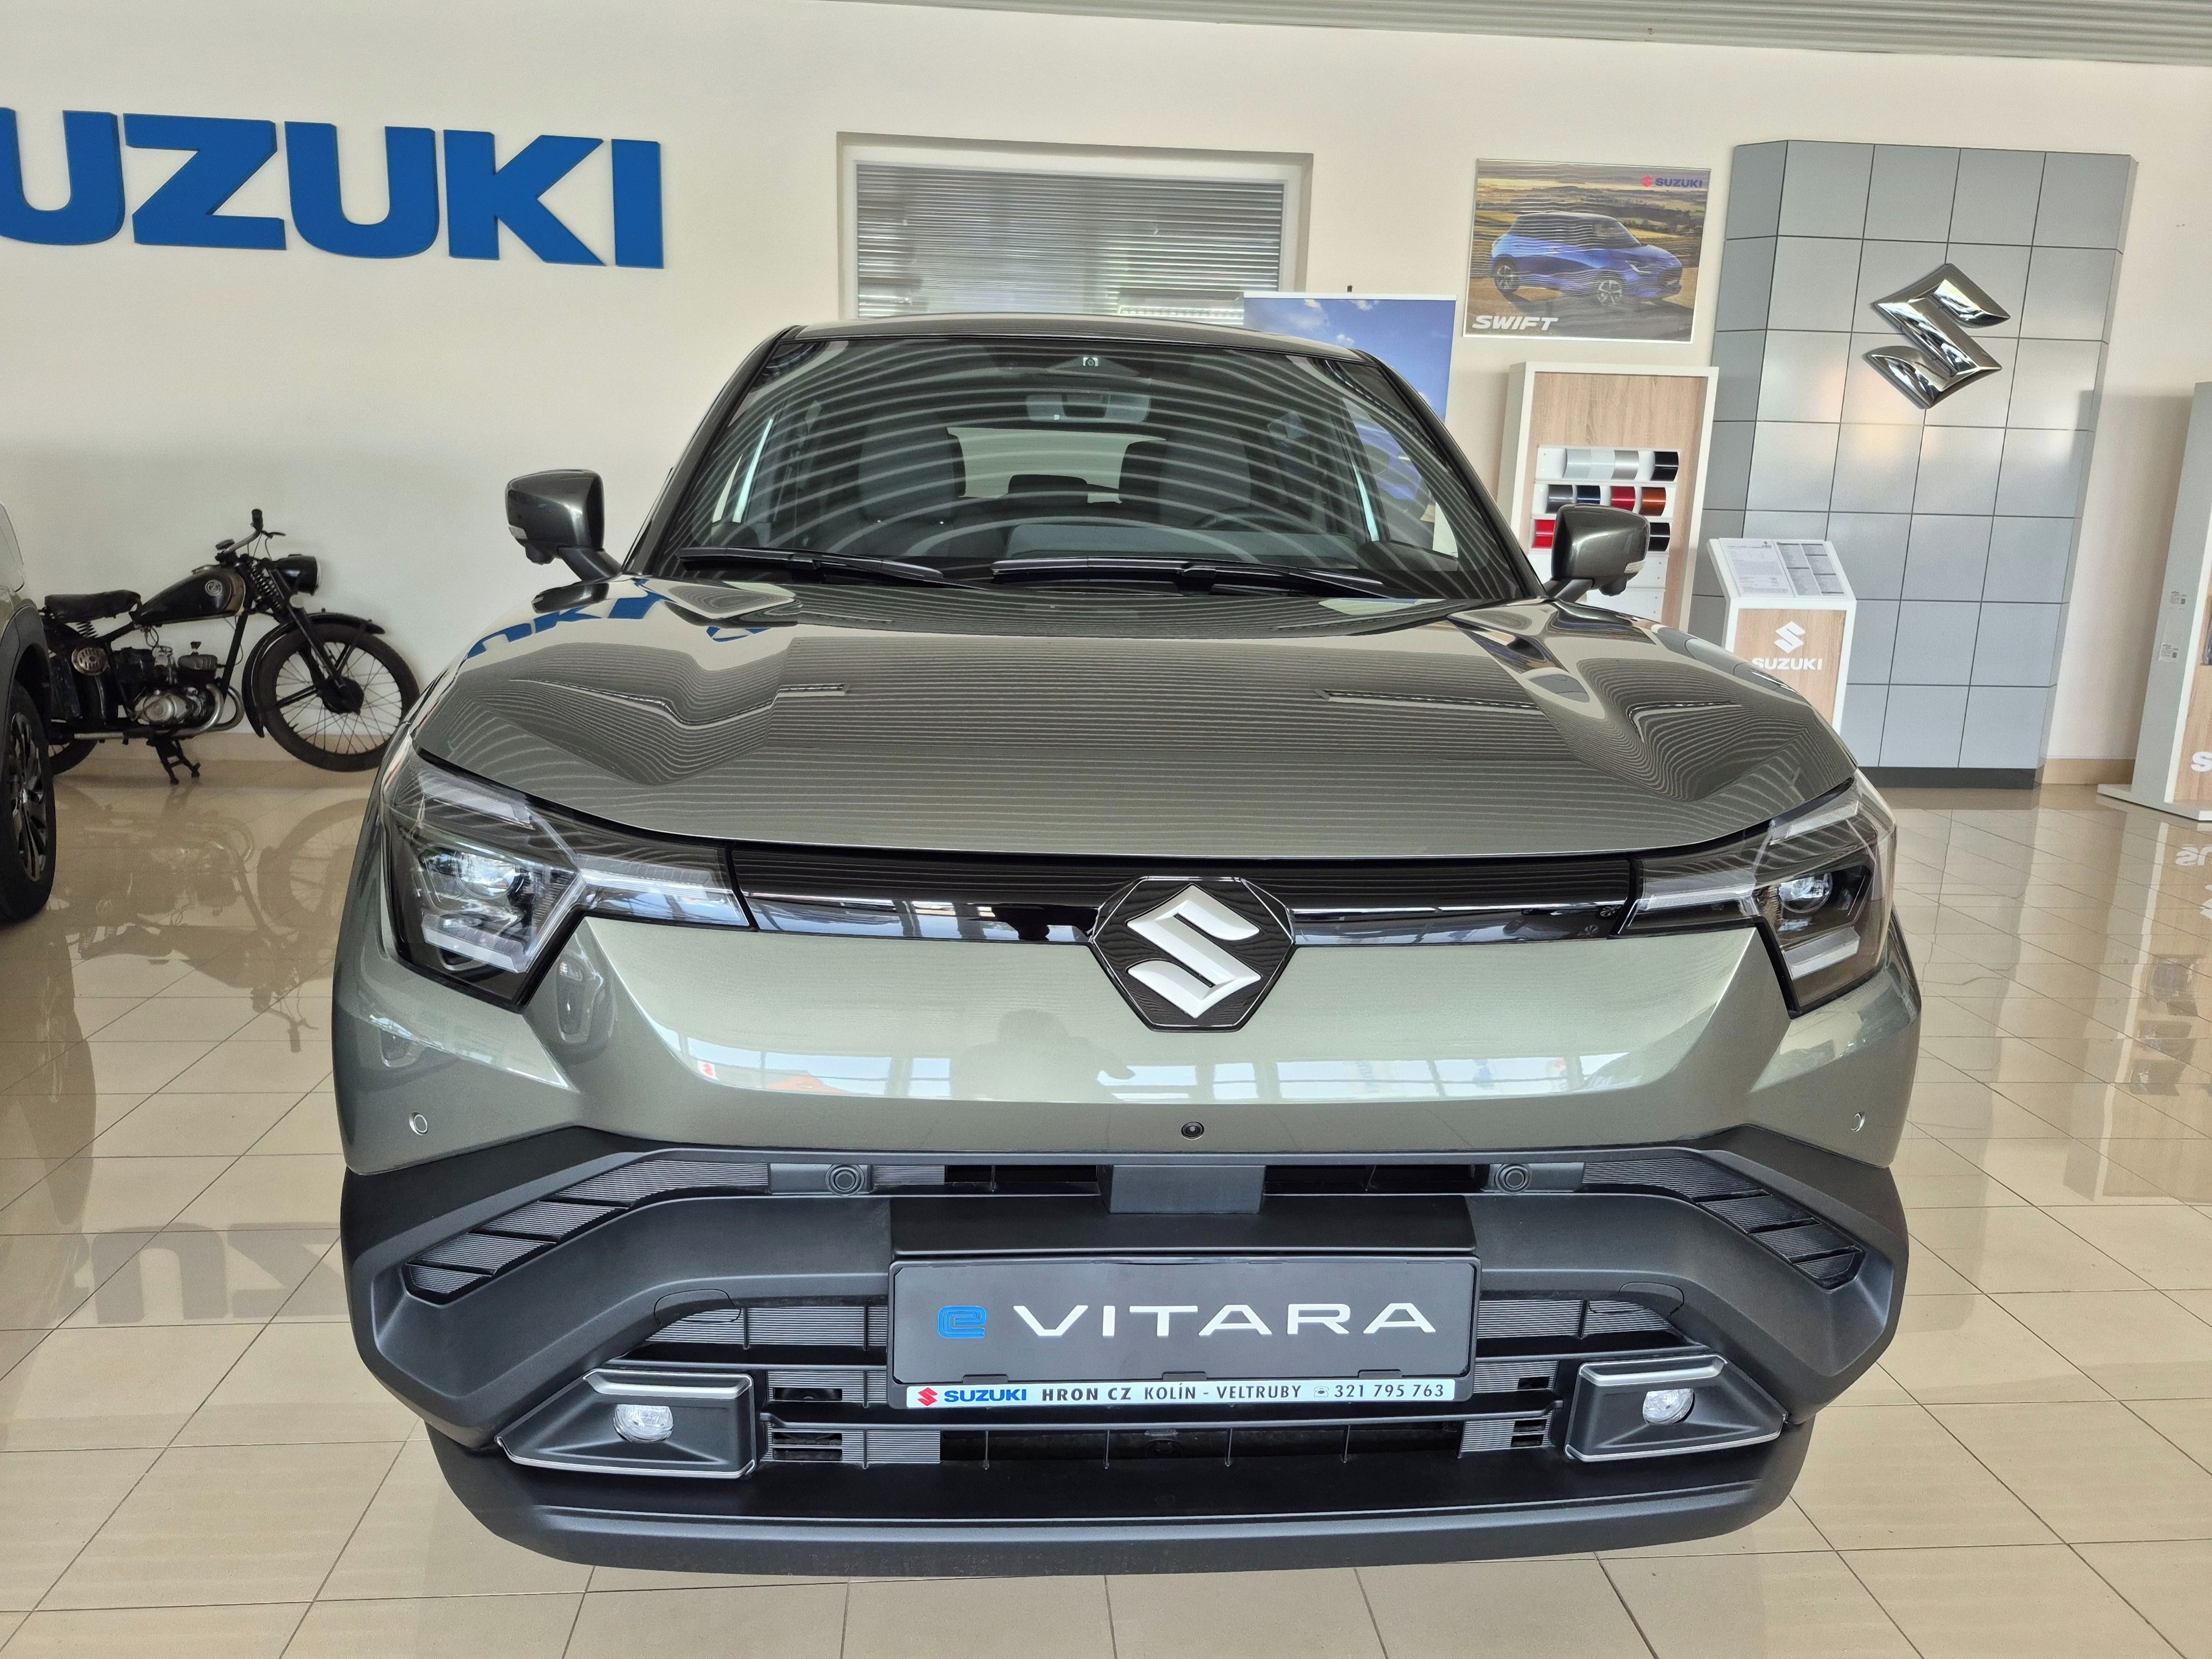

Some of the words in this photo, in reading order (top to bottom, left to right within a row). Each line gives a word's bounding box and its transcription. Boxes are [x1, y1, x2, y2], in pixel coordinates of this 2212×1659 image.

[1655, 178, 1703, 188] SUZUKI
[1472, 315, 1559, 331] SWIFT
[1751, 658, 1823, 670] SUZUKI
[1013, 1302, 1436, 1337] VITARA
[944, 1389, 1027, 1402] SUZUKI
[1042, 1389, 1098, 1401] HRON
[1108, 1387, 1131, 1400] CZ
[1144, 1383, 1196, 1400] KOLÍN
[1216, 1385, 1302, 1399] VELTRUBY
[1334, 1385, 1365, 1398] 321
[1374, 1384, 1405, 1397] 795
[1412, 1384, 1444, 1397] 763
